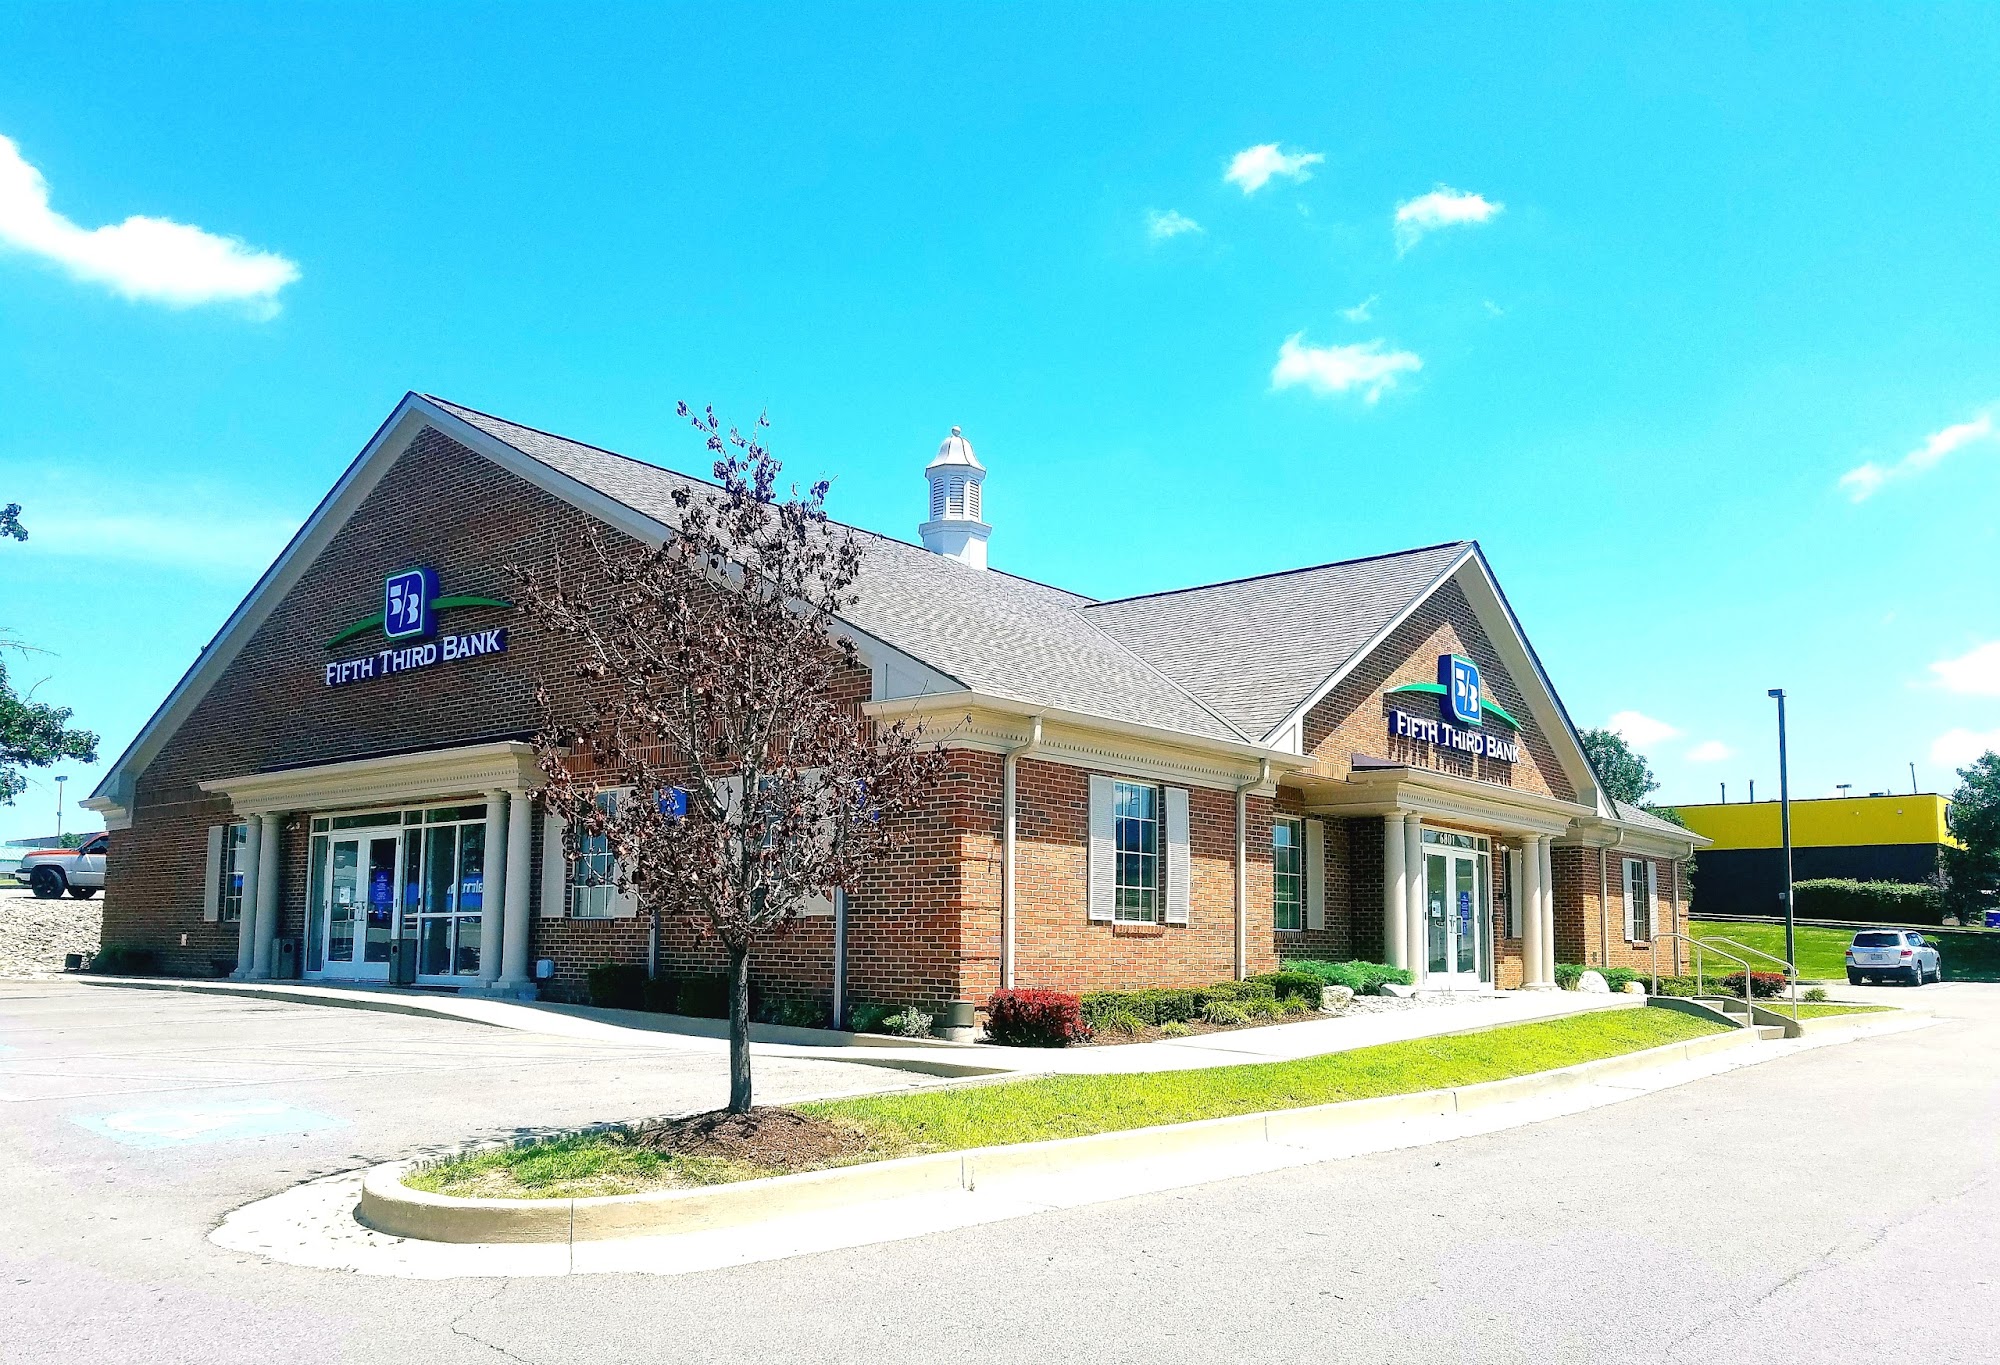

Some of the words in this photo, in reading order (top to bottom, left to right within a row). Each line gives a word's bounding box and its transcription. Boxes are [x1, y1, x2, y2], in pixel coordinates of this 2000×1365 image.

[326, 657, 374, 685] FIFTH
[380, 644, 436, 674] THIRD
[443, 629, 500, 661] BANK
[1396, 710, 1439, 744] FIFTH
[1441, 724, 1484, 754] THIRD
[1486, 735, 1520, 763] BANK
[1440, 832, 1455, 846] 6801
